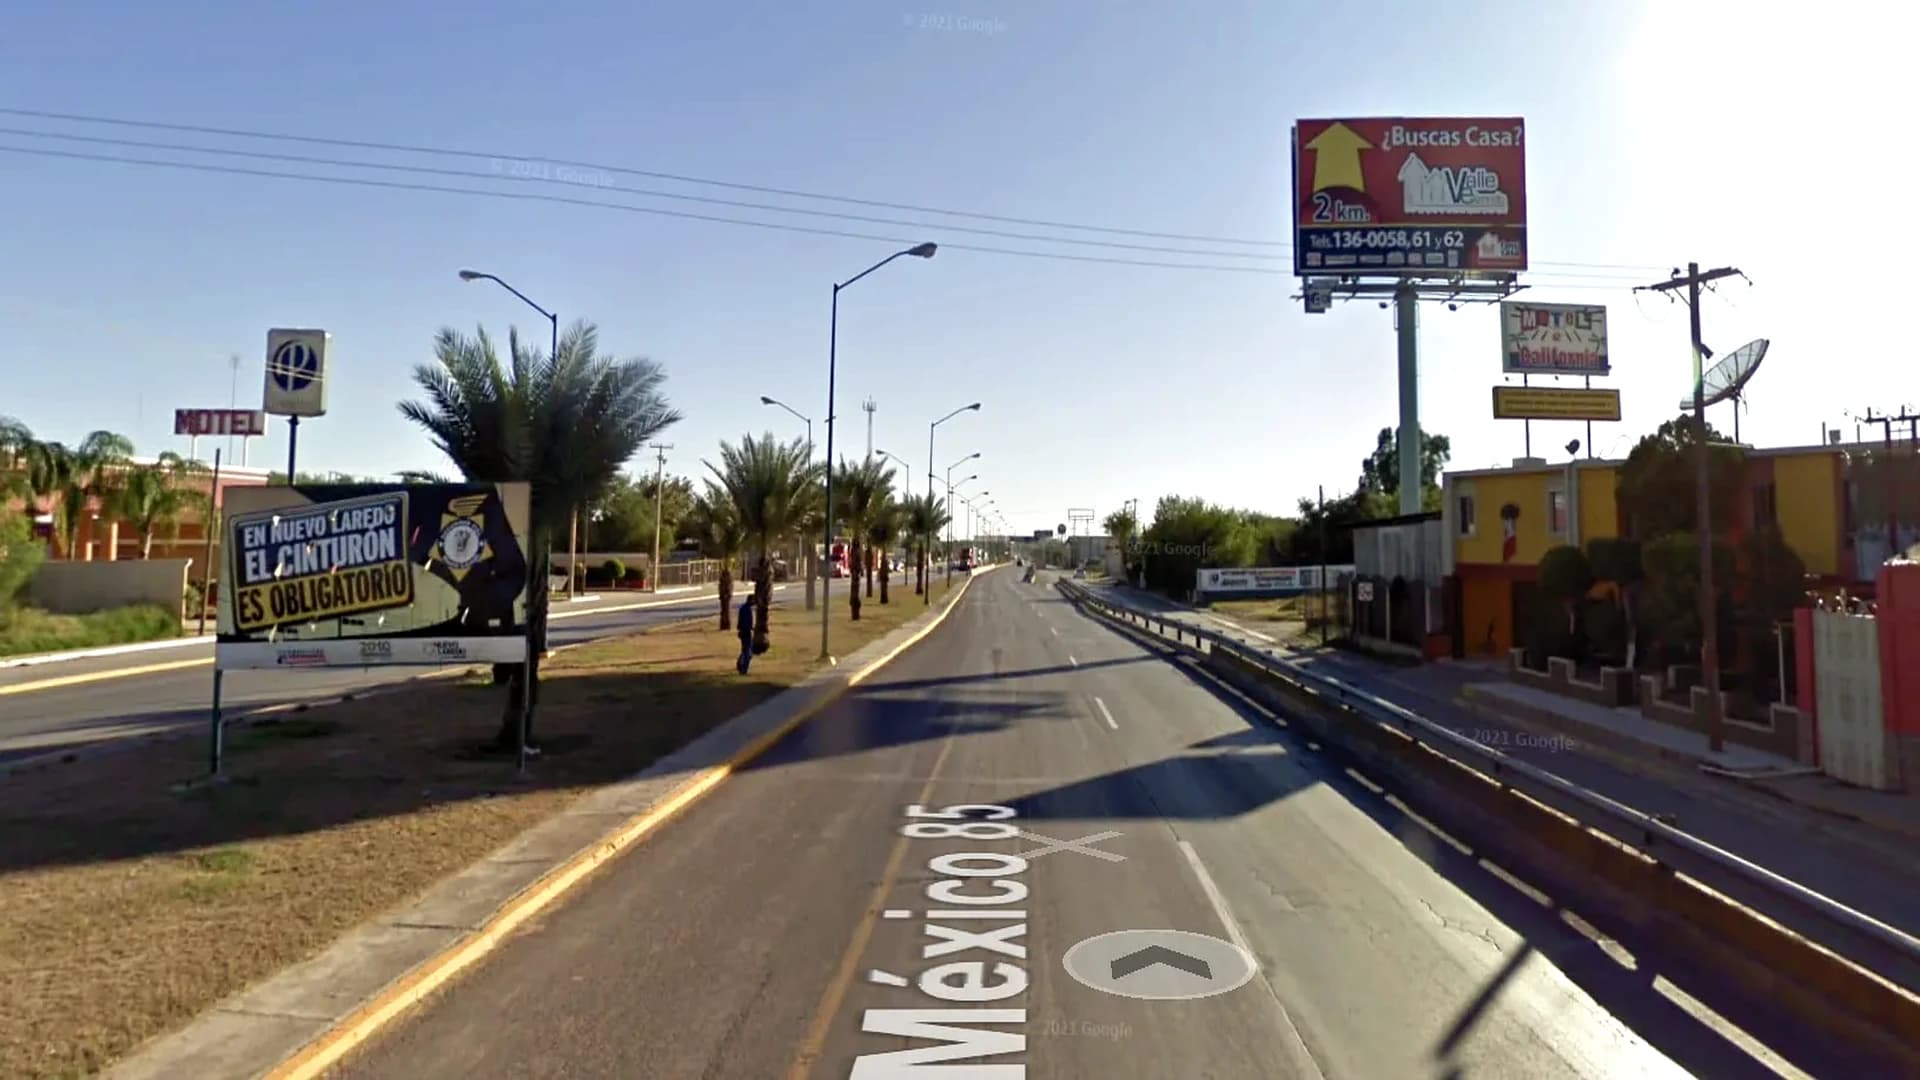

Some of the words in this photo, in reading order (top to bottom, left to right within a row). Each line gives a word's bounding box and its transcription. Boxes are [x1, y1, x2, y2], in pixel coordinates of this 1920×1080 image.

[1381, 126, 1460, 151] ¿Buscas
[1465, 125, 1523, 147] Casa?
[1312, 192, 1332, 223] 2
[1335, 200, 1371, 222] km.
[1434, 236, 1442, 250] y
[1443, 231, 1465, 248] 62
[175, 409, 264, 435] MOTEL
[243, 525, 268, 549] EN
[271, 514, 327, 543] NUEVO
[331, 504, 396, 533] LAREDO
[244, 551, 271, 583] EL
[276, 523, 396, 577] CINTURÓN
[237, 587, 264, 625] ES
